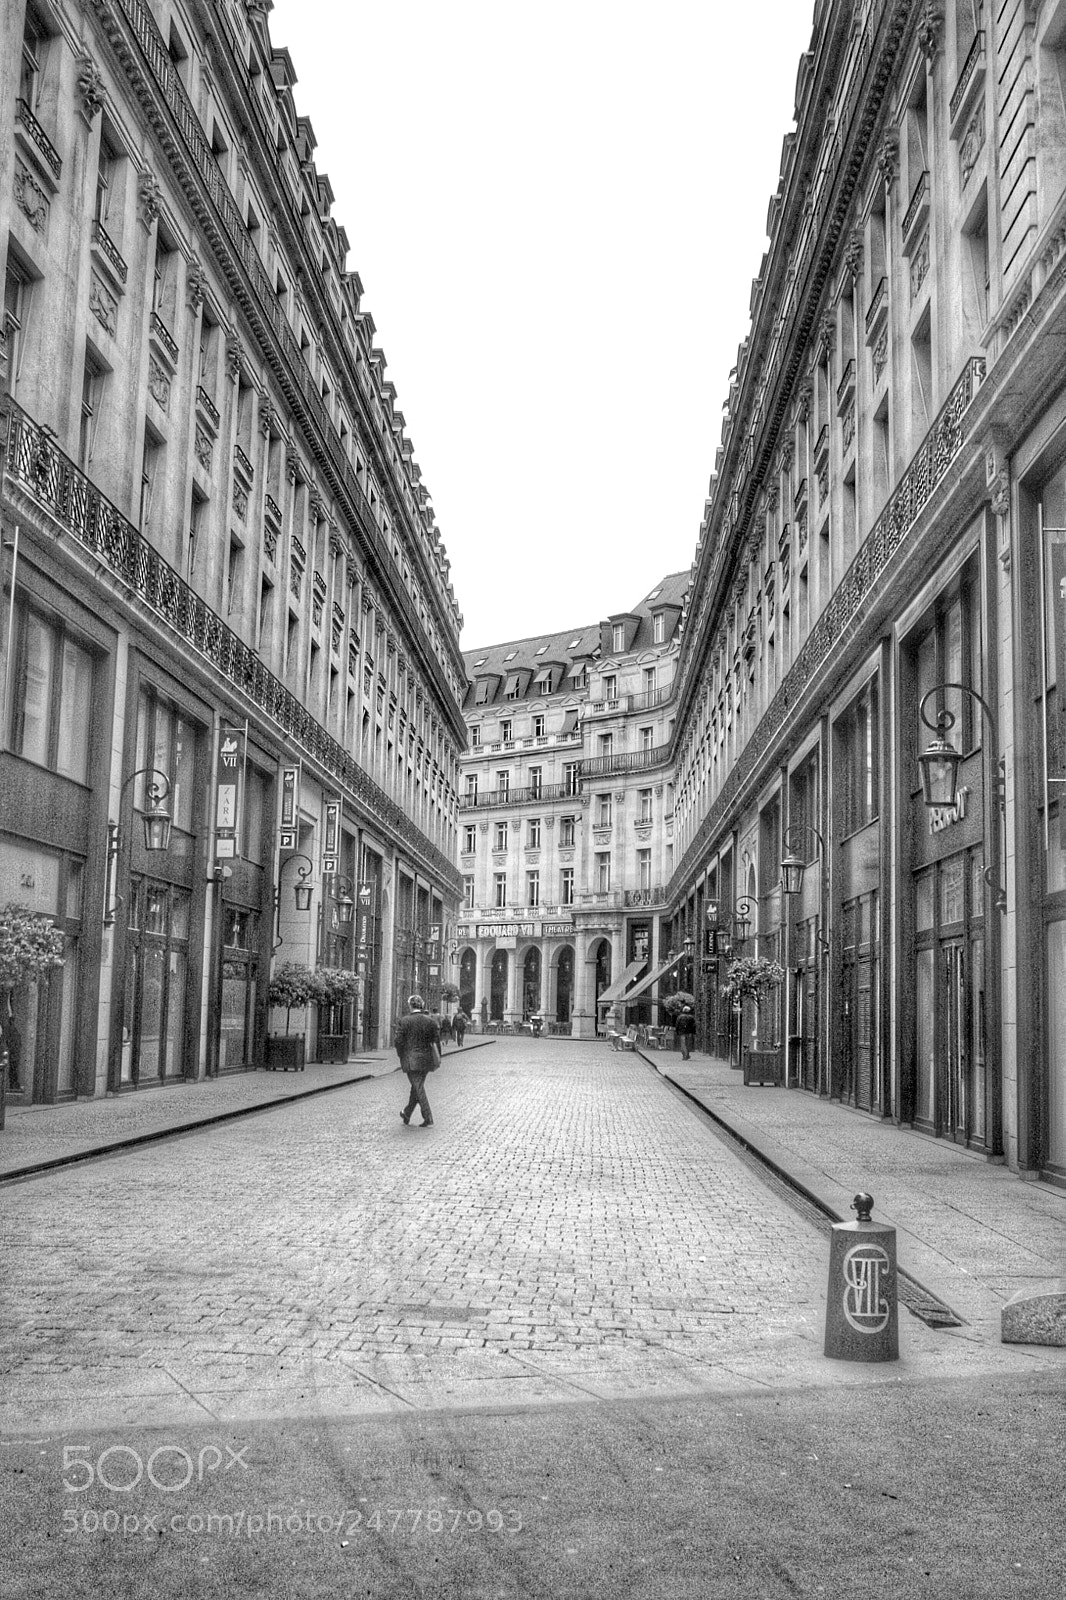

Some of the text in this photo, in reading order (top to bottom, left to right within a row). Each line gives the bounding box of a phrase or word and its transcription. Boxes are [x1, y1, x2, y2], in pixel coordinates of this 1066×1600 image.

[222, 757, 237, 768] VII
[222, 787, 230, 825] ZARA
[283, 838, 290, 846] P
[326, 862, 333, 870] P
[520, 924, 533, 936] VII
